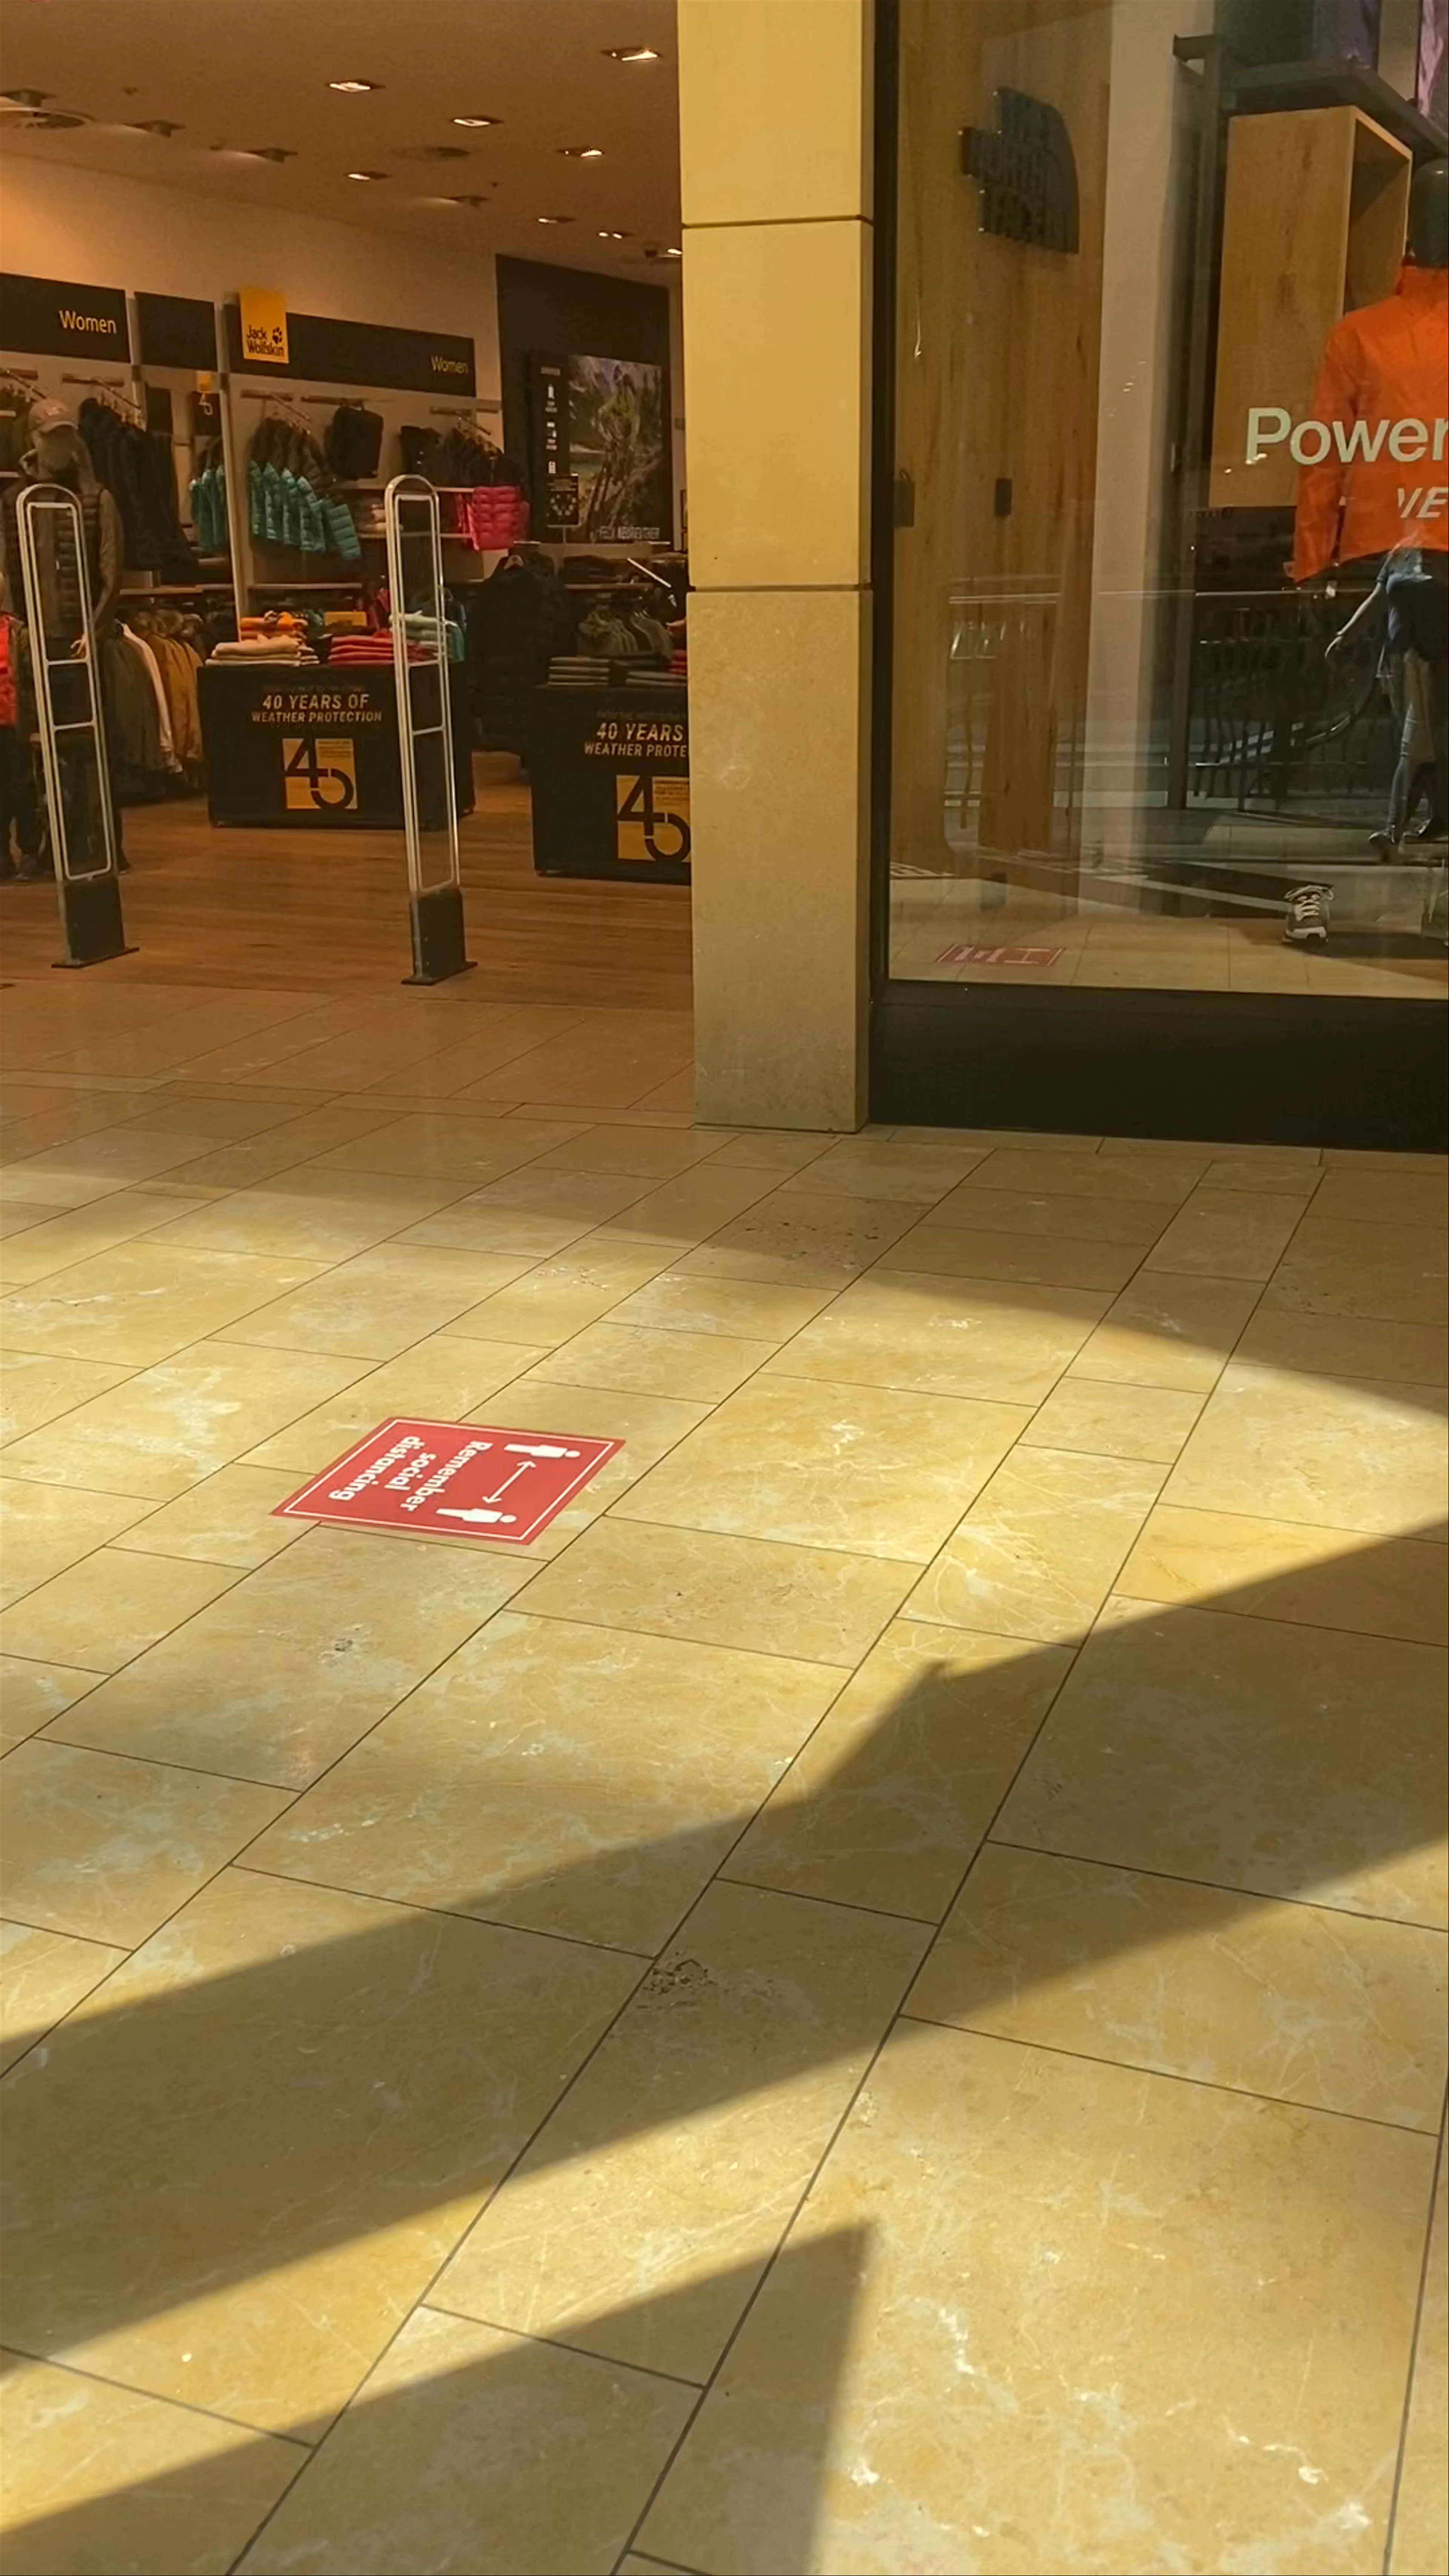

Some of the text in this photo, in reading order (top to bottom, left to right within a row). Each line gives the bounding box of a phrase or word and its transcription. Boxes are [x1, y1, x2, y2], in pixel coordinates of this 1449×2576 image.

[59, 310, 117, 334] Women
[246, 325, 267, 340] Jack
[246, 339, 284, 357] Wolfskin
[431, 355, 468, 375] Women
[262, 694, 370, 709] 40 YEARS OF
[251, 711, 382, 723] WEATHER PROTECTION
[597, 722, 685, 742] 40 YEARS
[584, 742, 687, 758] WEATHER PROTE
[328, 1436, 425, 1501] distancing
[384, 1452, 436, 1491] social
[400, 1441, 493, 1512] Remember
